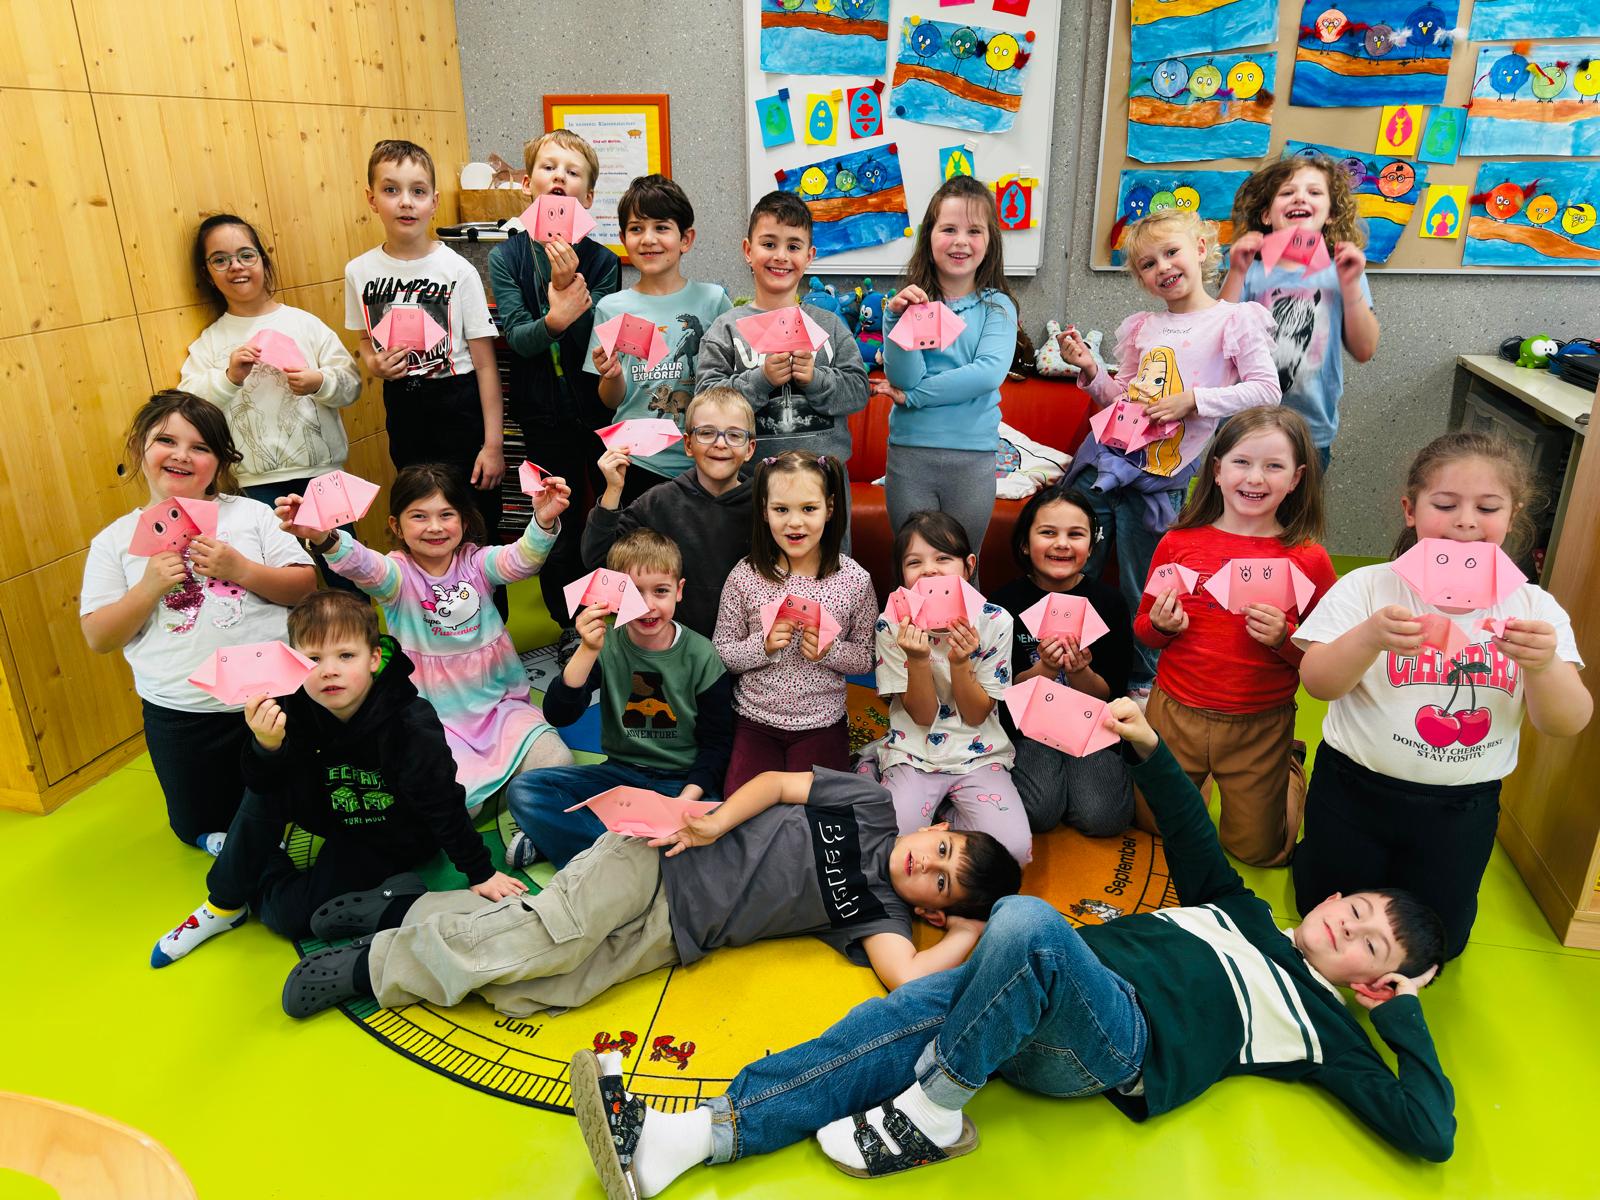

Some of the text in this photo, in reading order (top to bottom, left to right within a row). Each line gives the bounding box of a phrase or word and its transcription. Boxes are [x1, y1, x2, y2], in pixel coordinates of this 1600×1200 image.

[631, 362, 683, 374] DINSAUR
[633, 370, 681, 382] EXPLORER
[1392, 733, 1428, 750] DOING
[1430, 745, 1448, 755] MY
[1487, 738, 1503, 748] BEST
[1416, 749, 1445, 762] STAY
[1104, 835, 1137, 896] September
[493, 1016, 544, 1039] Juni
